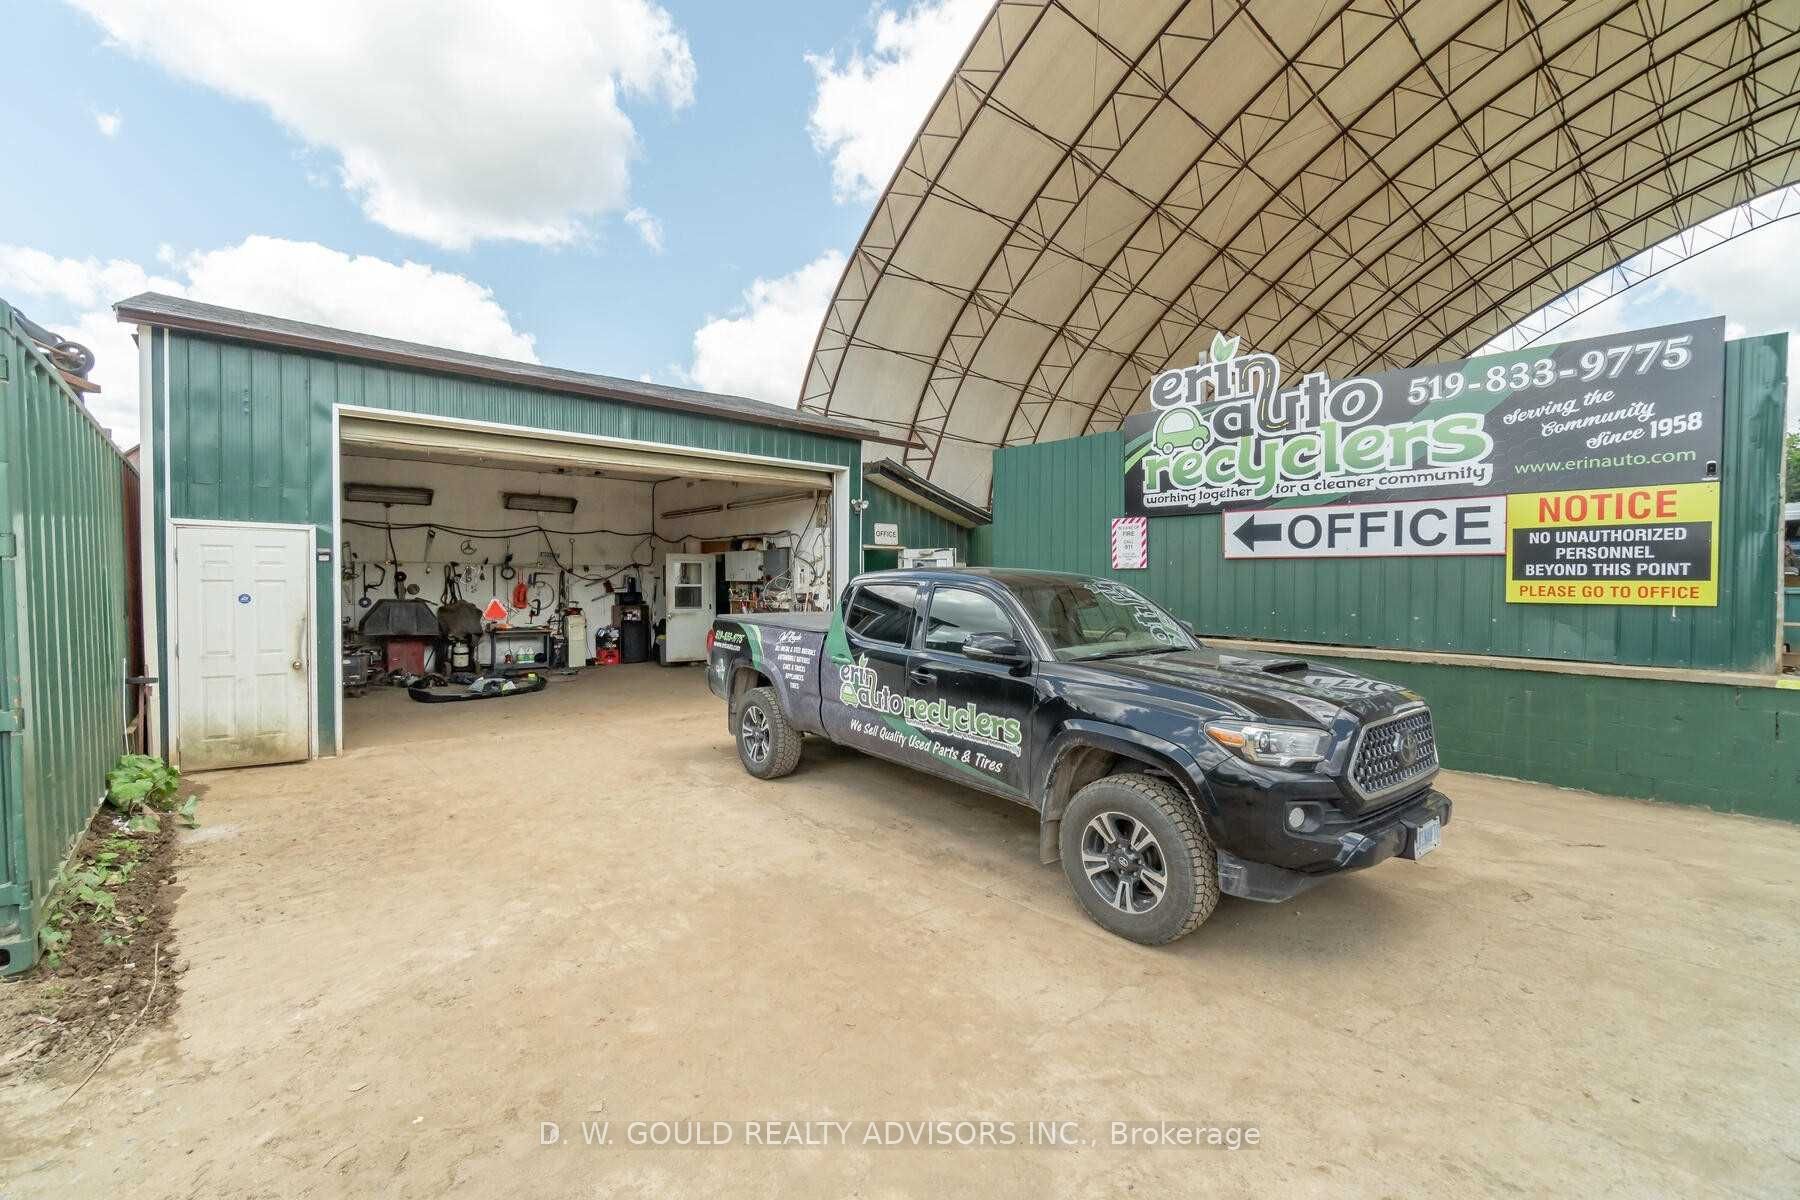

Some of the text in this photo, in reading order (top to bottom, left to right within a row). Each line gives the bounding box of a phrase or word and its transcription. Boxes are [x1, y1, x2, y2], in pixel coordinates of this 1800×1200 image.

[1150, 332, 1280, 409] erin
[1408, 334, 1693, 405] 519-833-9775
[1211, 372, 1384, 441] auto
[1503, 389, 1615, 424] Serving the
[1541, 401, 1656, 437] Community
[1586, 411, 1703, 449] Since 1958
[1142, 411, 1493, 499] recyclers
[1514, 449, 1697, 475] www.erinauto.com
[1146, 465, 1486, 503] working together for a cleaner community
[1539, 489, 1678, 523] NOTICE
[1287, 505, 1492, 549] OFFICE
[1529, 527, 1687, 544] NO UNAUTHORIZED
[1525, 562, 1691, 576] BEYOND THIS POINT
[1555, 546, 1655, 560] PERSONNEL
[1519, 585, 1700, 599] PLEASE GO TO OFFICE
[840, 652, 877, 688] erin
[857, 685, 903, 715] auto
[903, 697, 1022, 746] recyclers
[850, 719, 862, 732] We
[864, 723, 878, 737] Sell
[879, 727, 907, 748] Quality
[909, 735, 932, 752] Used
[933, 742, 959, 760] Parts
[962, 750, 971, 763] &
[975, 752, 1003, 773] Tires
